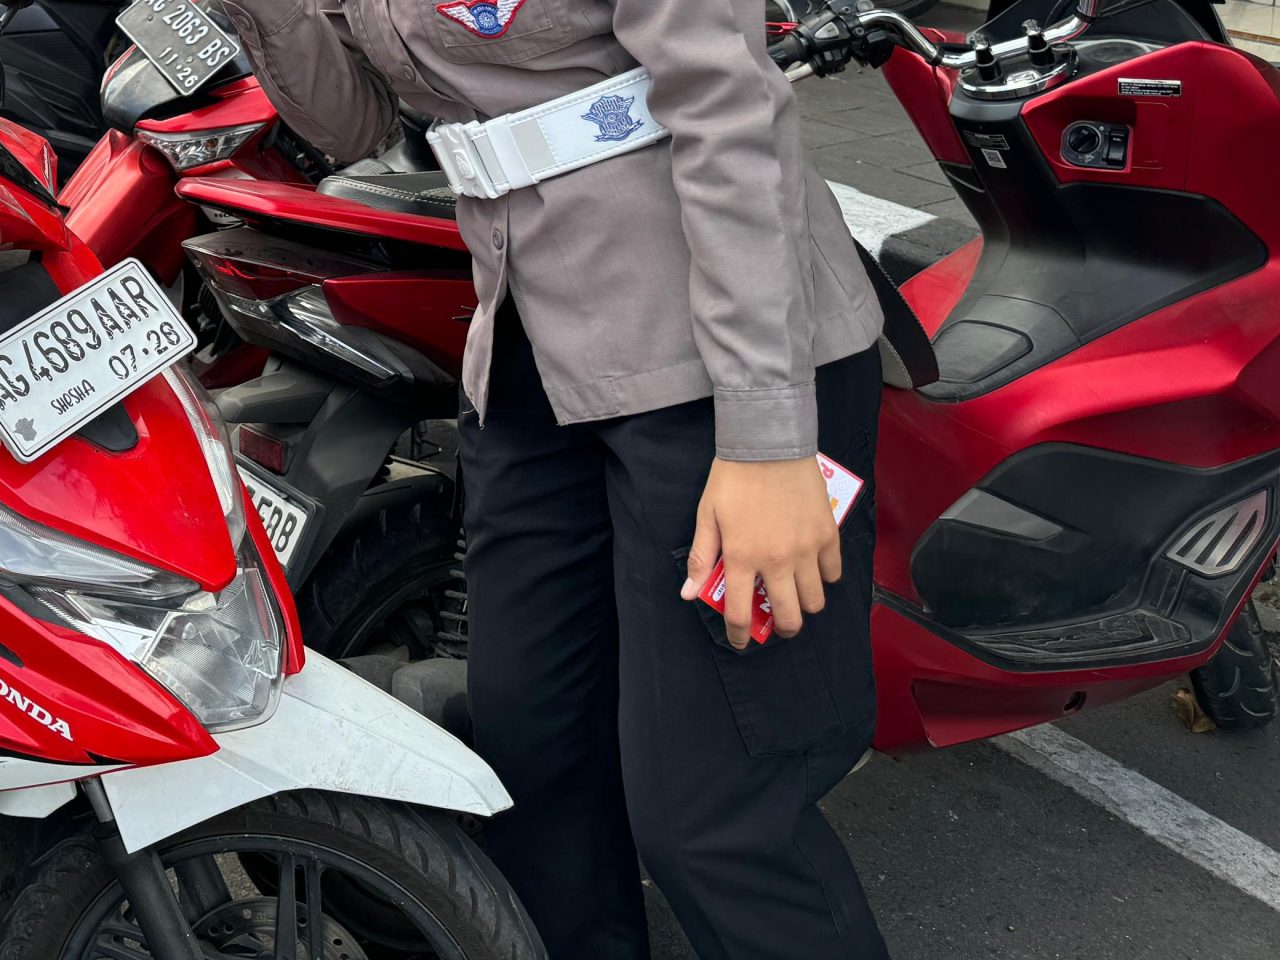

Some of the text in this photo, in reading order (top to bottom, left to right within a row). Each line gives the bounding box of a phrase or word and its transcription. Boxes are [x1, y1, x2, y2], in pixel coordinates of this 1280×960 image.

[162, 3, 209, 45] 2063
[198, 37, 230, 66] BS
[23, 309, 102, 383] 4689
[91, 275, 160, 340] AAR
